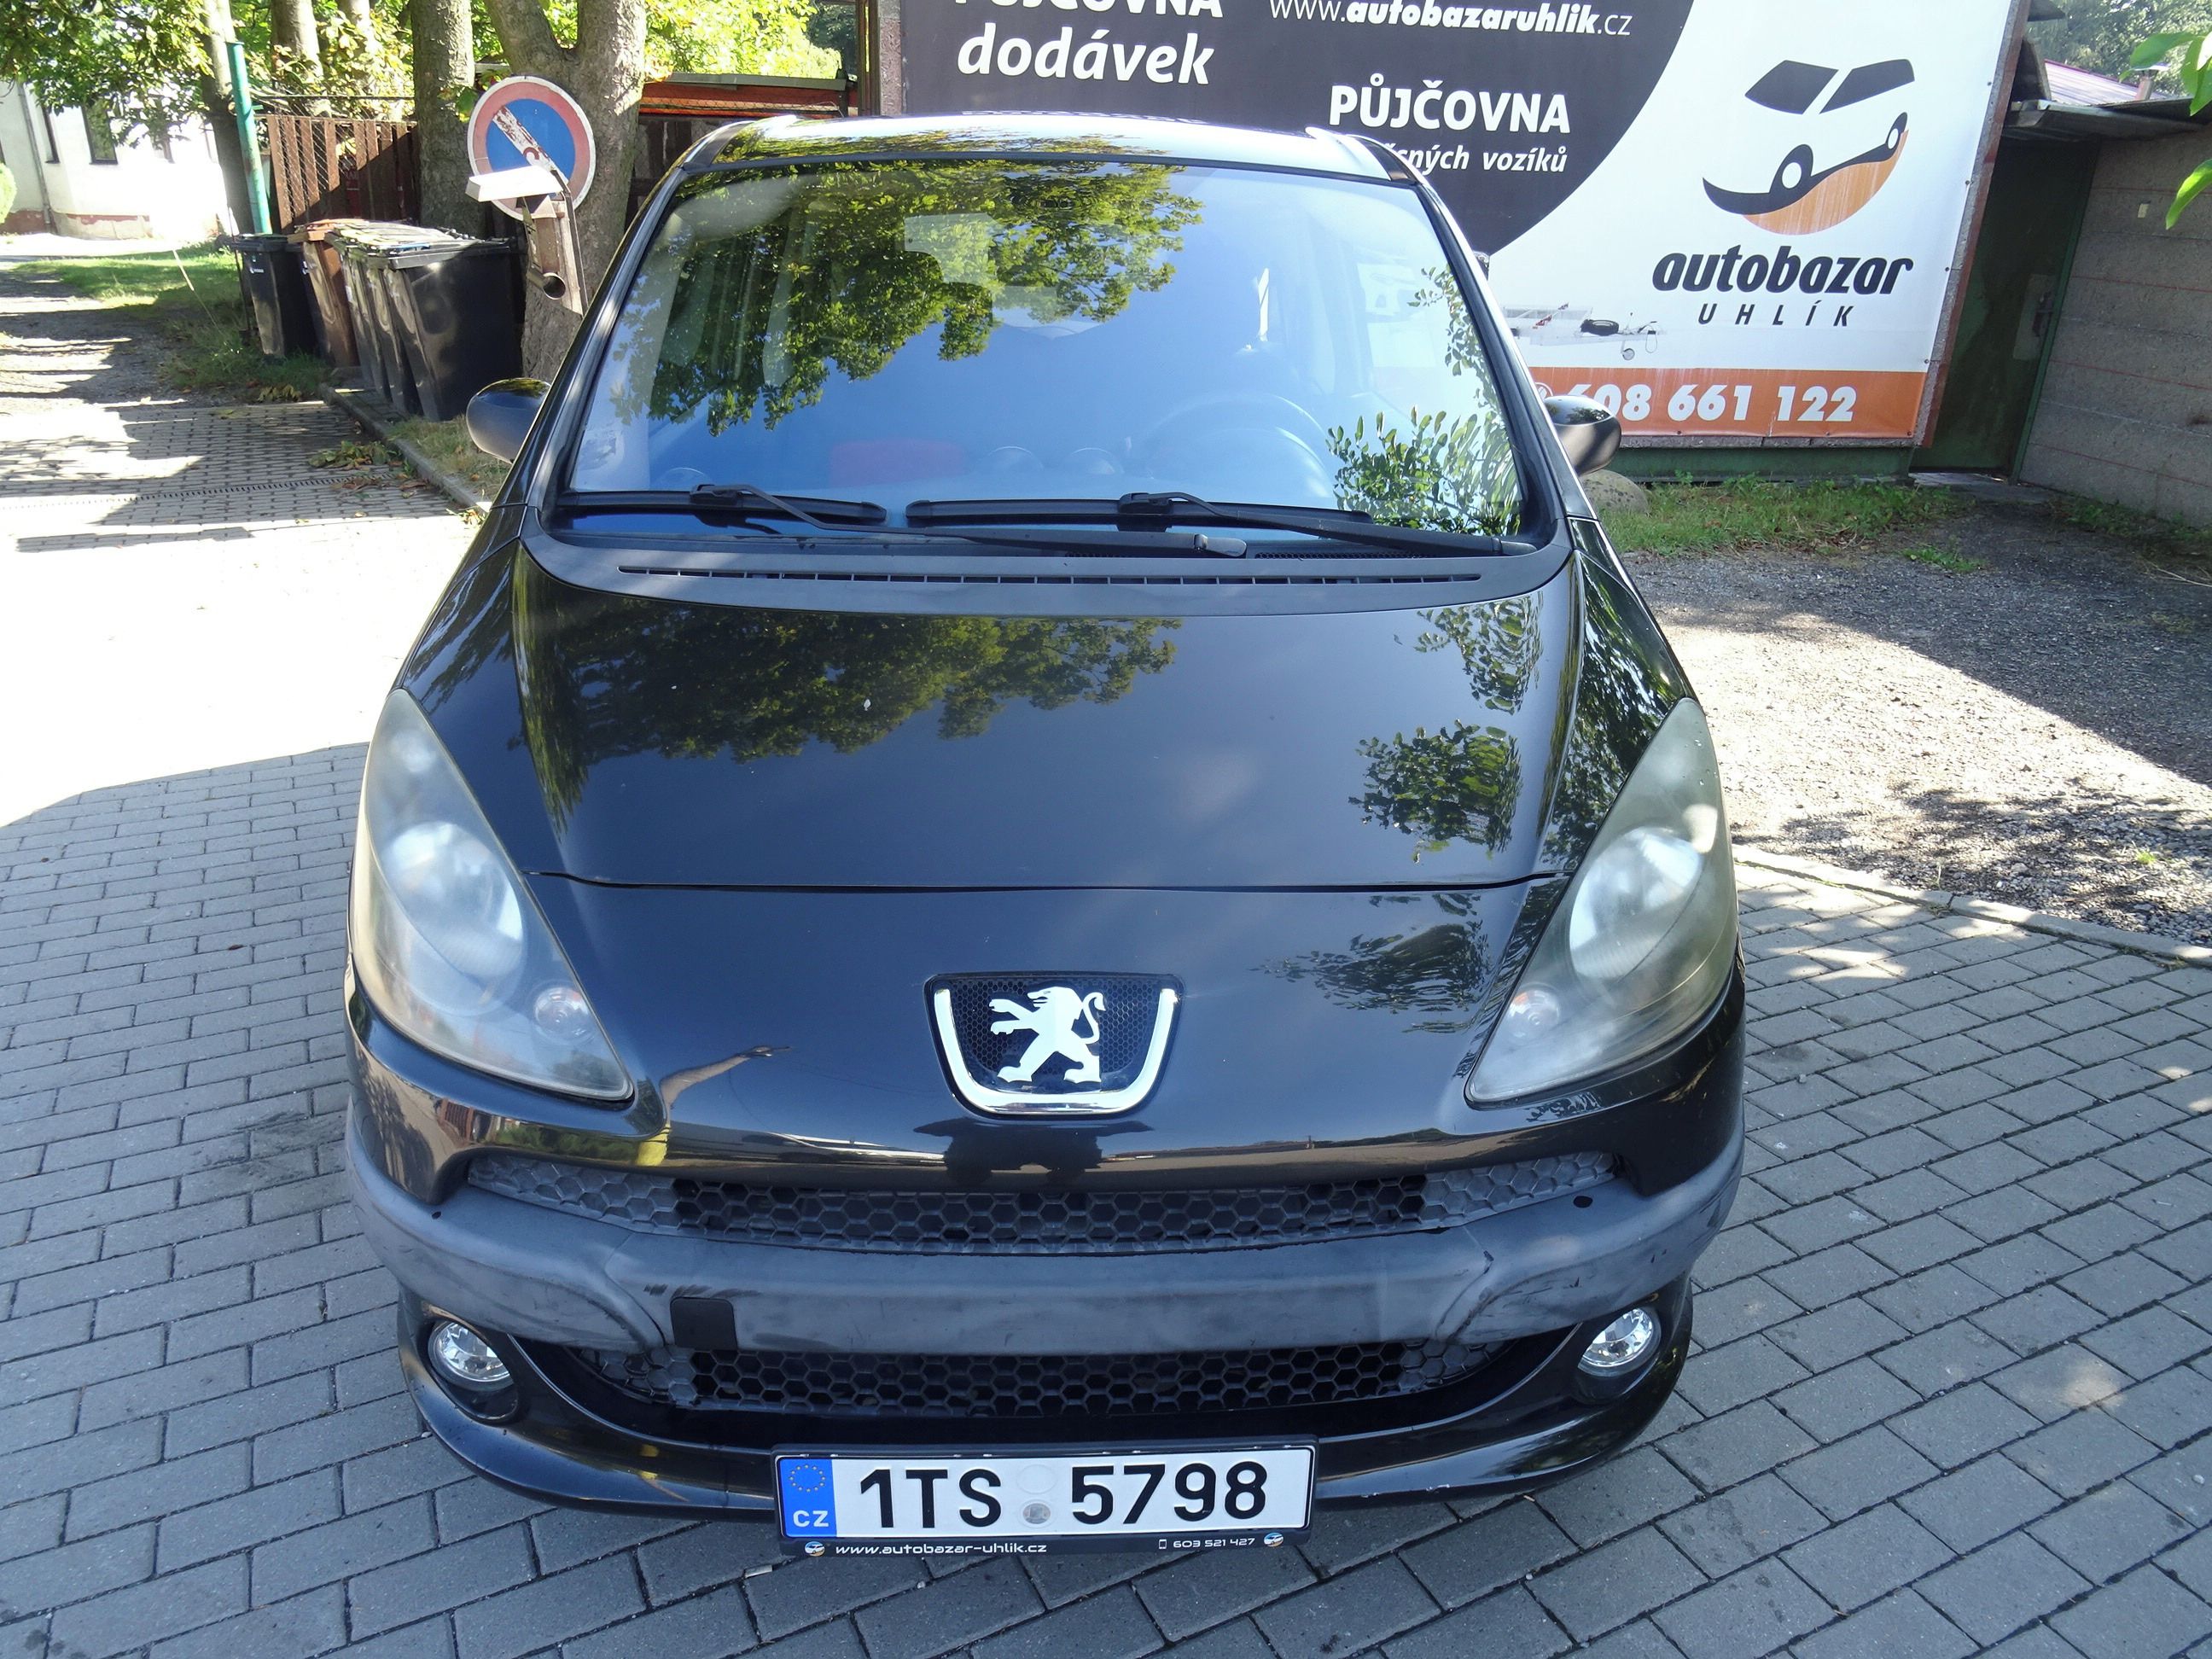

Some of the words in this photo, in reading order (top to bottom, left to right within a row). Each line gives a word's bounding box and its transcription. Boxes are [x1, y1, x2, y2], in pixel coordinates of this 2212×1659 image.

[1269, 0, 1633, 36] www.autobazaruhlik.cz
[957, 22, 1215, 84] dodávek
[1329, 73, 1571, 133] PŮJČOVNA
[1482, 145, 1568, 172] vozíků
[1651, 244, 1914, 294] autobazar
[1697, 300, 1854, 327] UHLÍK
[1668, 384, 1752, 421] 661
[1776, 386, 1857, 422] 122
[859, 1468, 1002, 1528] 1TS
[1070, 1461, 1268, 1525] 5798
[793, 1510, 830, 1528] CZ
[835, 1542, 1047, 1555] www.autobazar-uhlik.cz
[1173, 1539, 1201, 1549] 603
[1204, 1539, 1226, 1548] 521
[1230, 1537, 1256, 1546] 427
